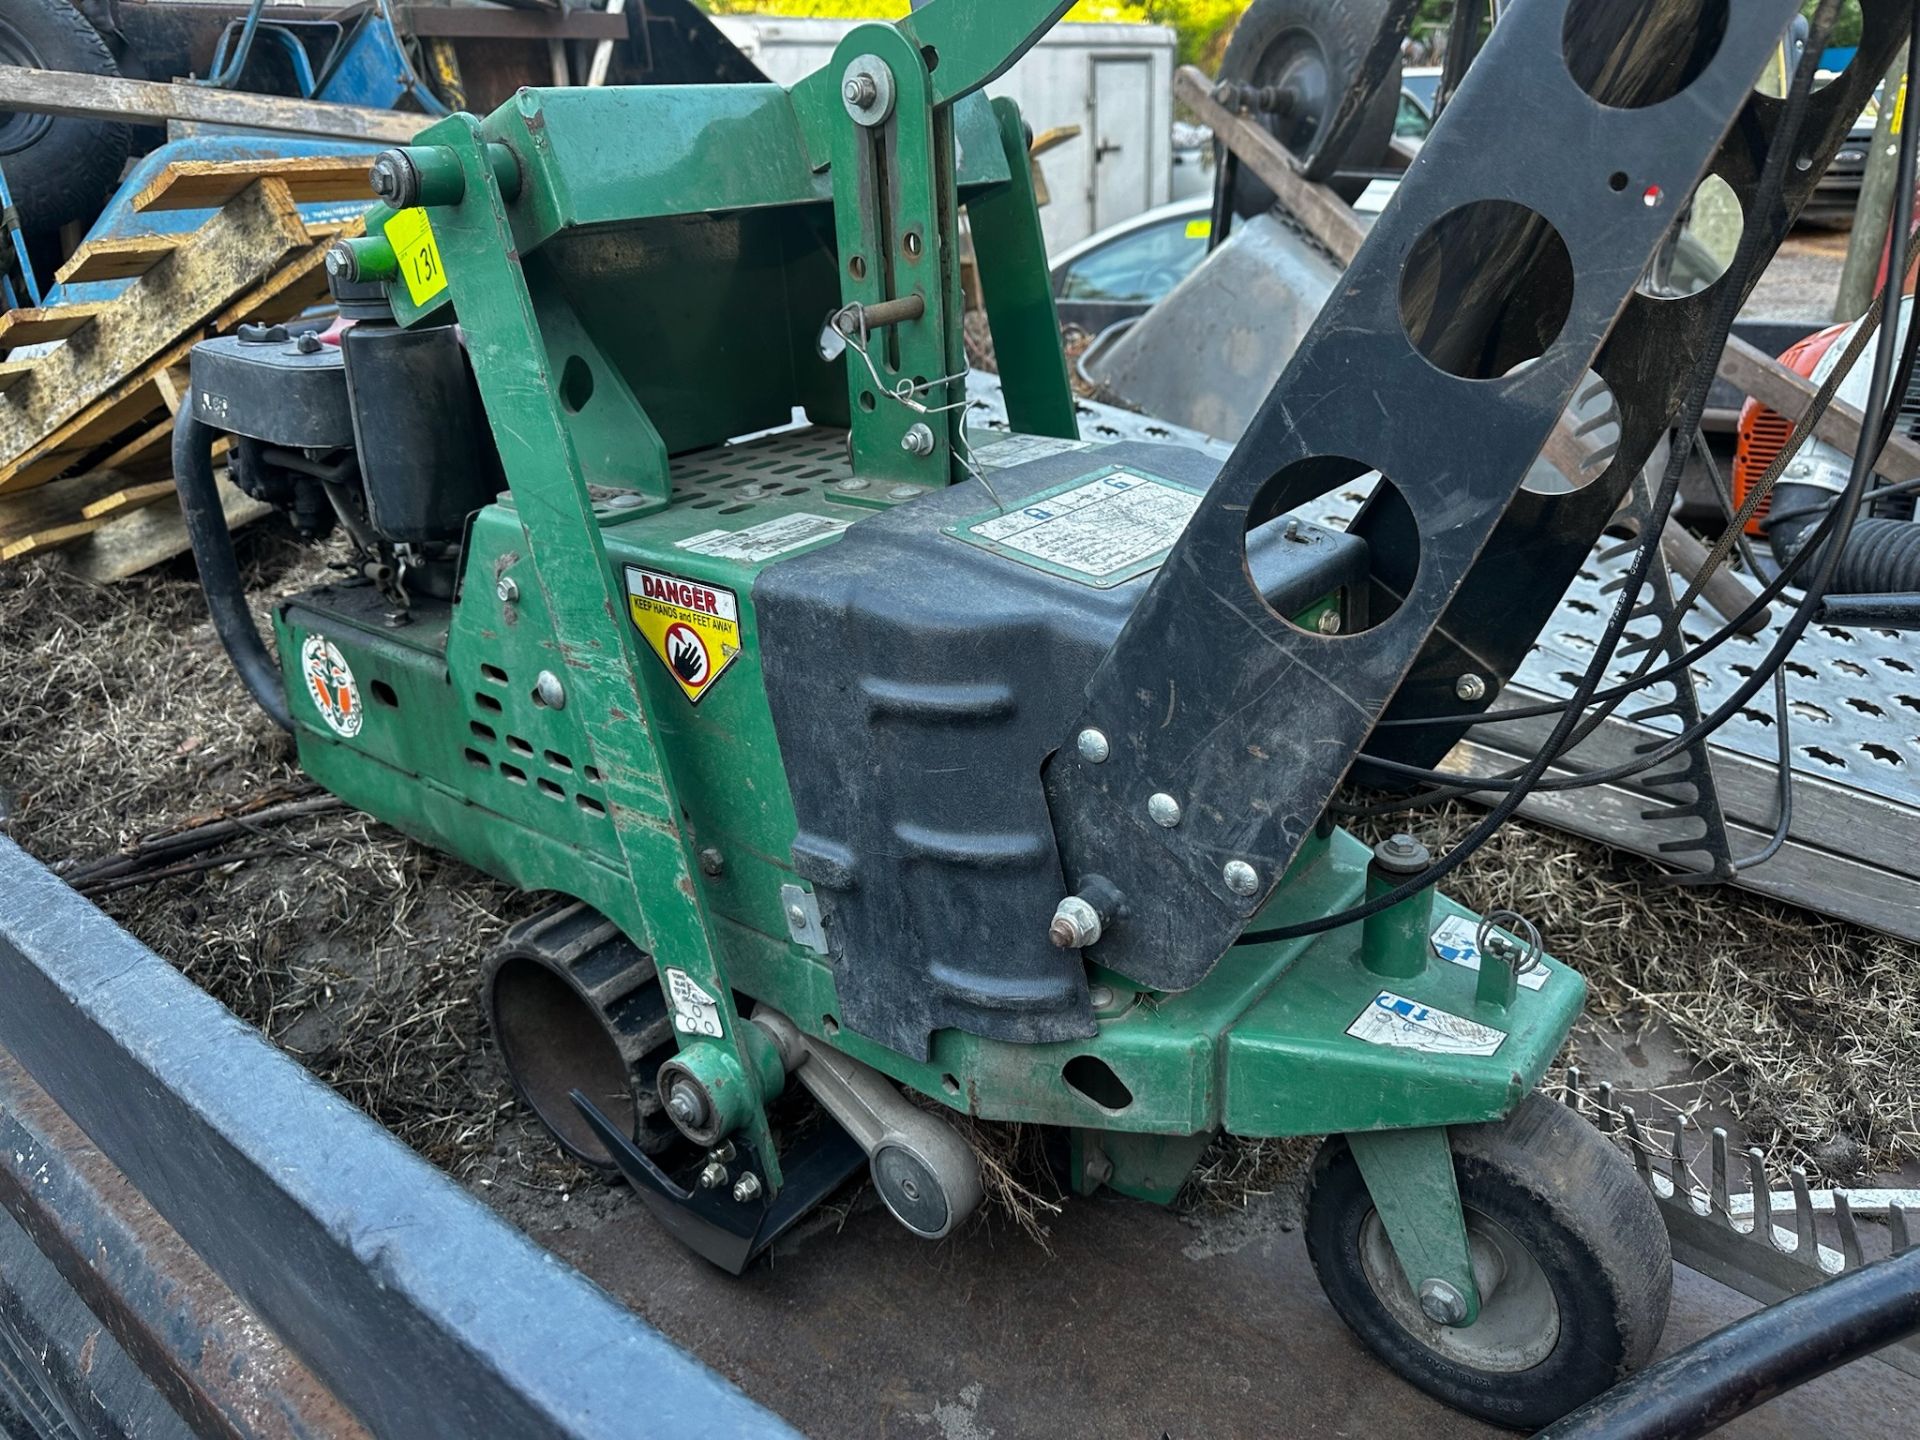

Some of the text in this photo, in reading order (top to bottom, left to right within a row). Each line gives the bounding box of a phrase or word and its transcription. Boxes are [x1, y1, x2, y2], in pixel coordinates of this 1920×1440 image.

[413, 243, 438, 285] 131
[641, 574, 719, 615] DANGER
[634, 597, 733, 634] KEEP HANDS and FEET AWAY
[1426, 1356, 1454, 1375] LOAD
